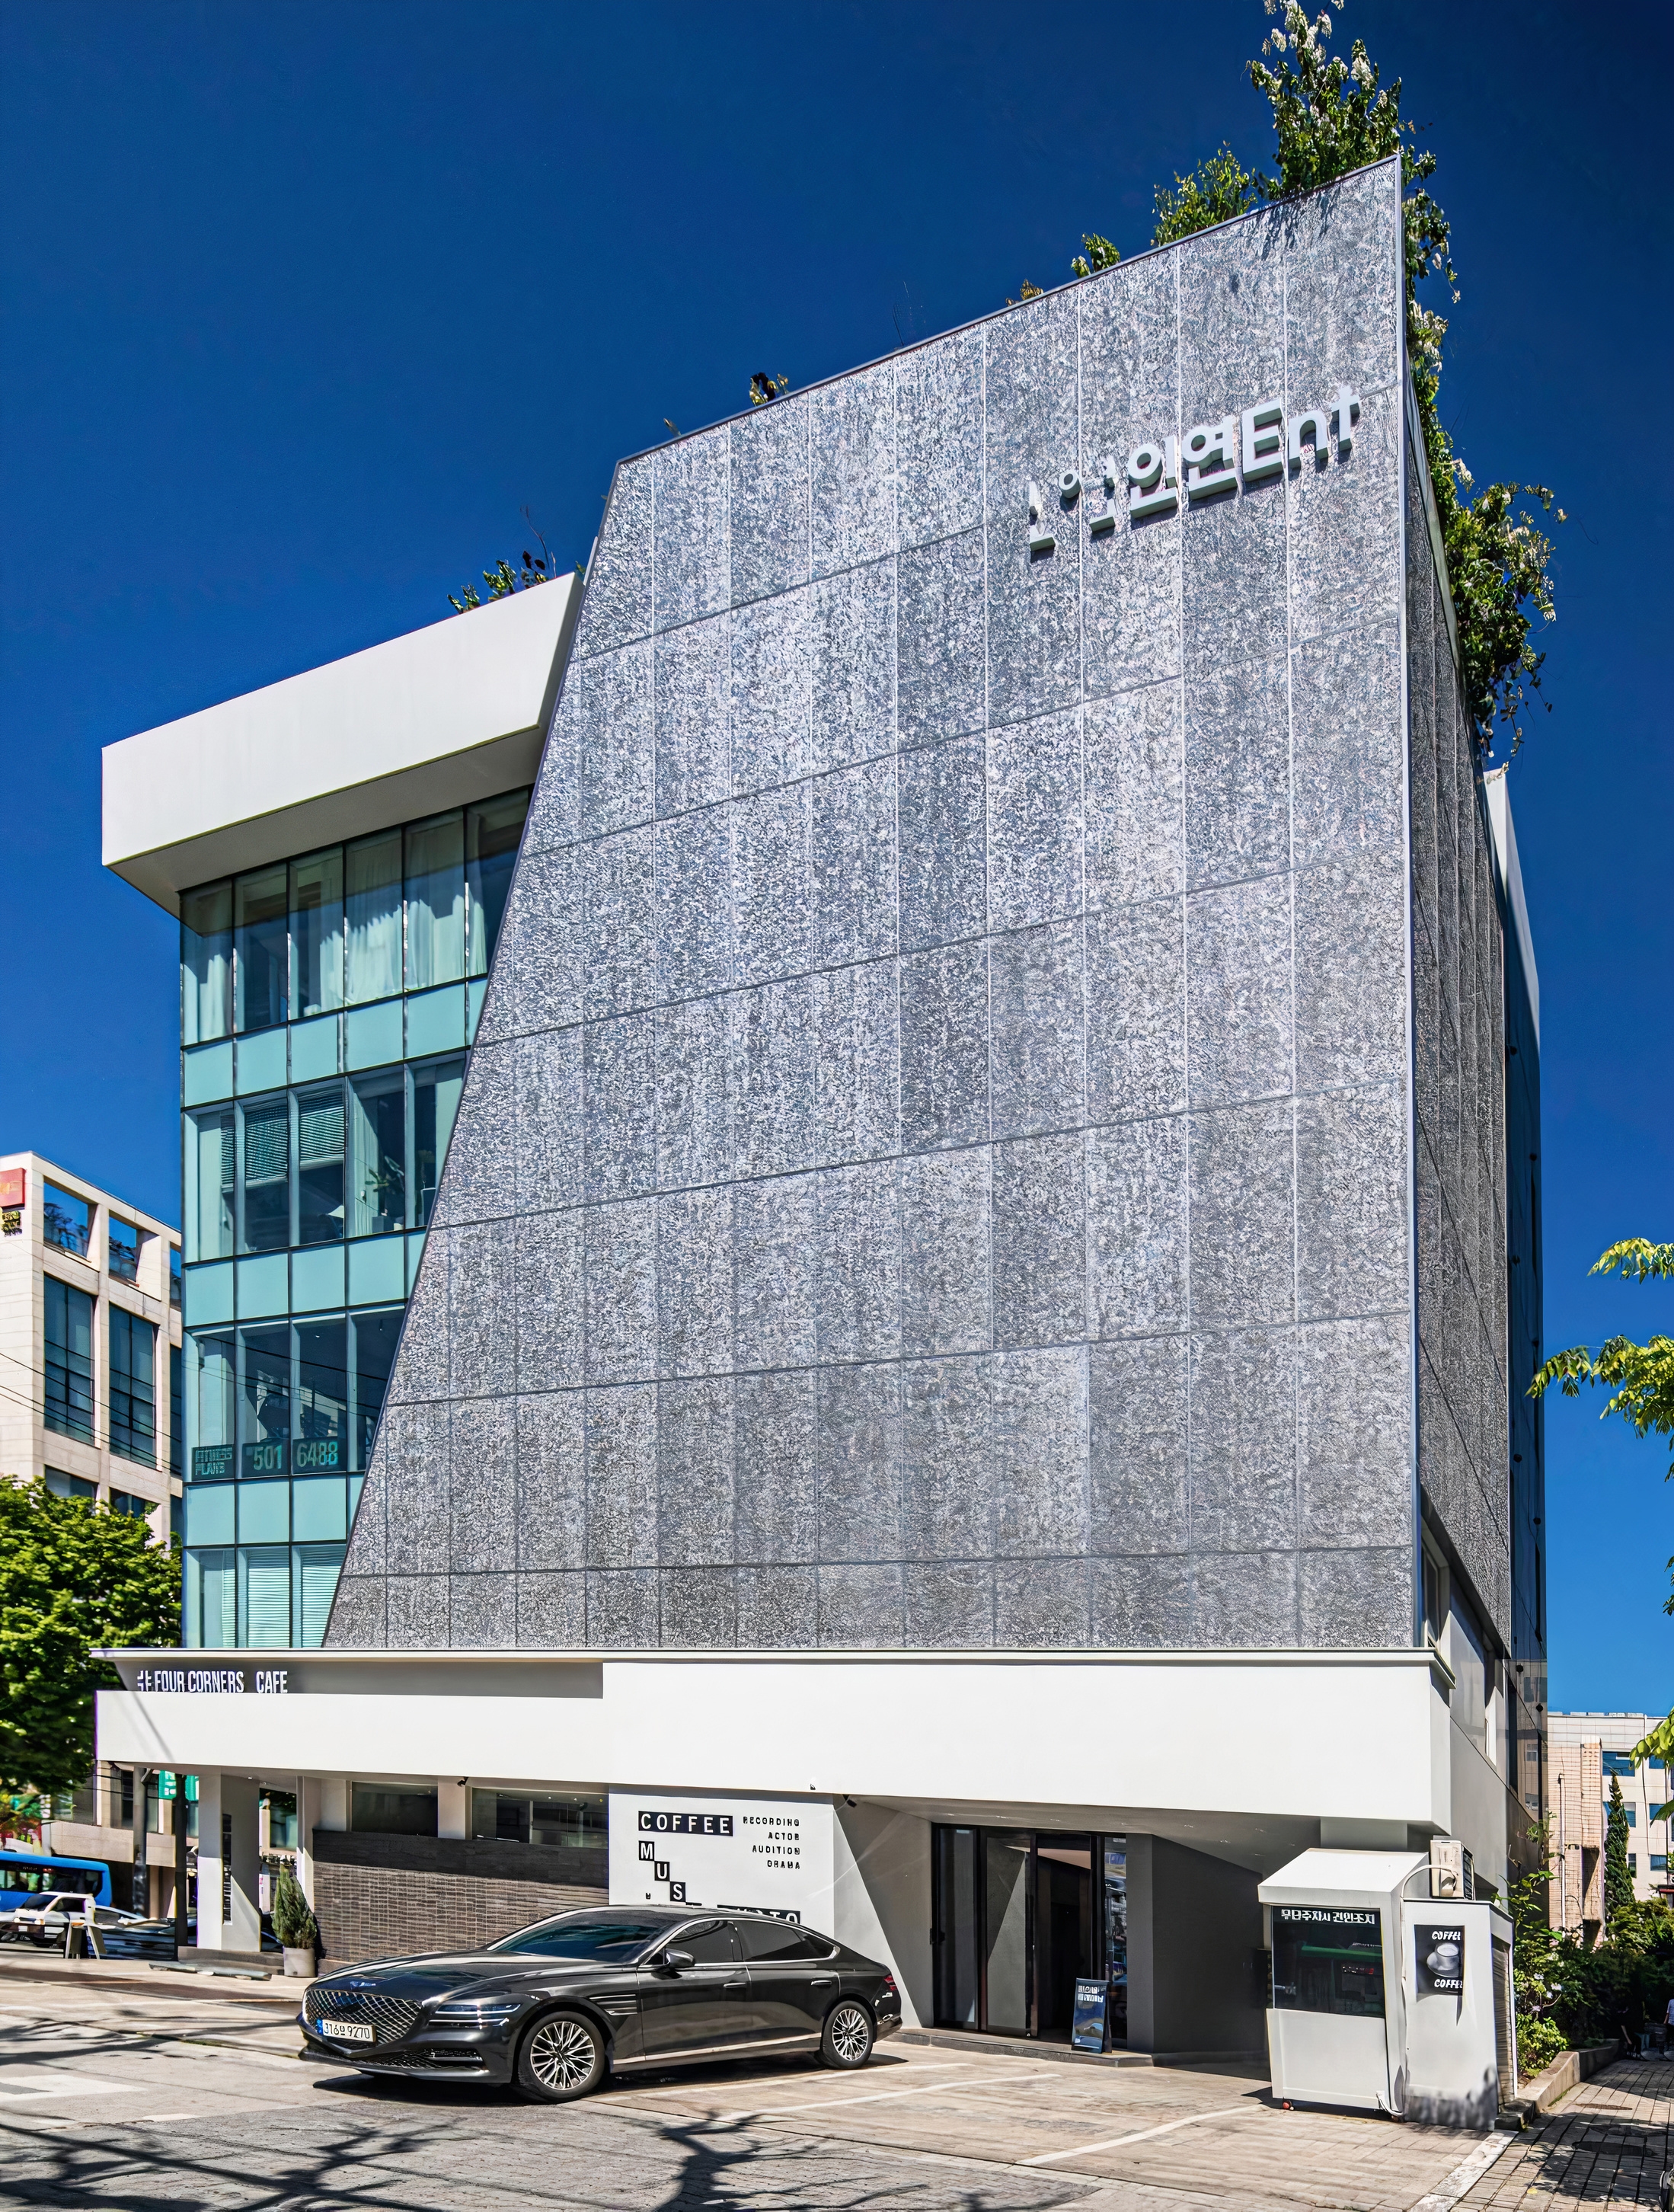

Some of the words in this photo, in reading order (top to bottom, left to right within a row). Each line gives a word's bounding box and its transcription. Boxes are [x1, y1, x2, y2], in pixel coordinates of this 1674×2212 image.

[154, 1670, 184, 1693] FOUR
[188, 1670, 244, 1693] CORNERS
[256, 1670, 288, 1693] CAFE
[641, 1813, 730, 1834] COFFEE
[743, 1816, 800, 1827] RECORDING
